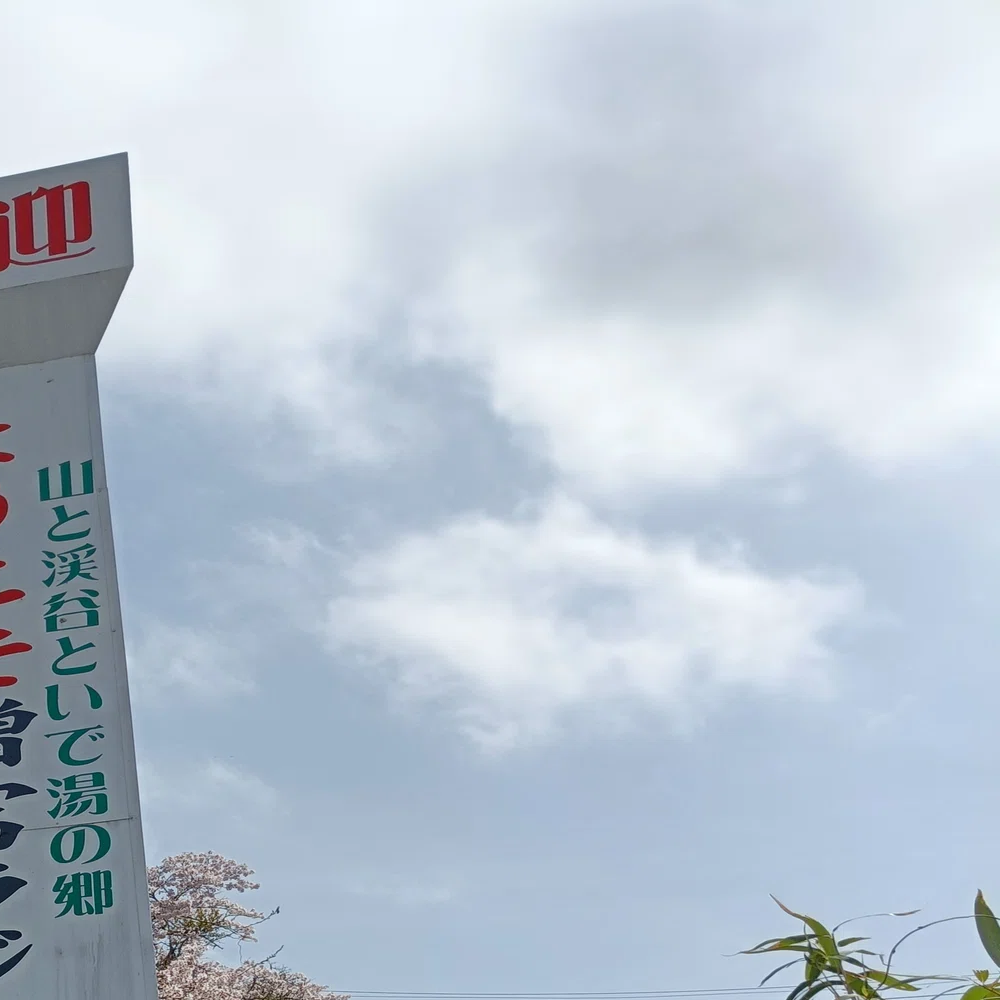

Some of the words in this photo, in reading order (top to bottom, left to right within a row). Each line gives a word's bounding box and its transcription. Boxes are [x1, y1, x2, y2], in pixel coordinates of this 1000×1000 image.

[37, 459, 114, 917] 山と渓谷といで湯の郷
